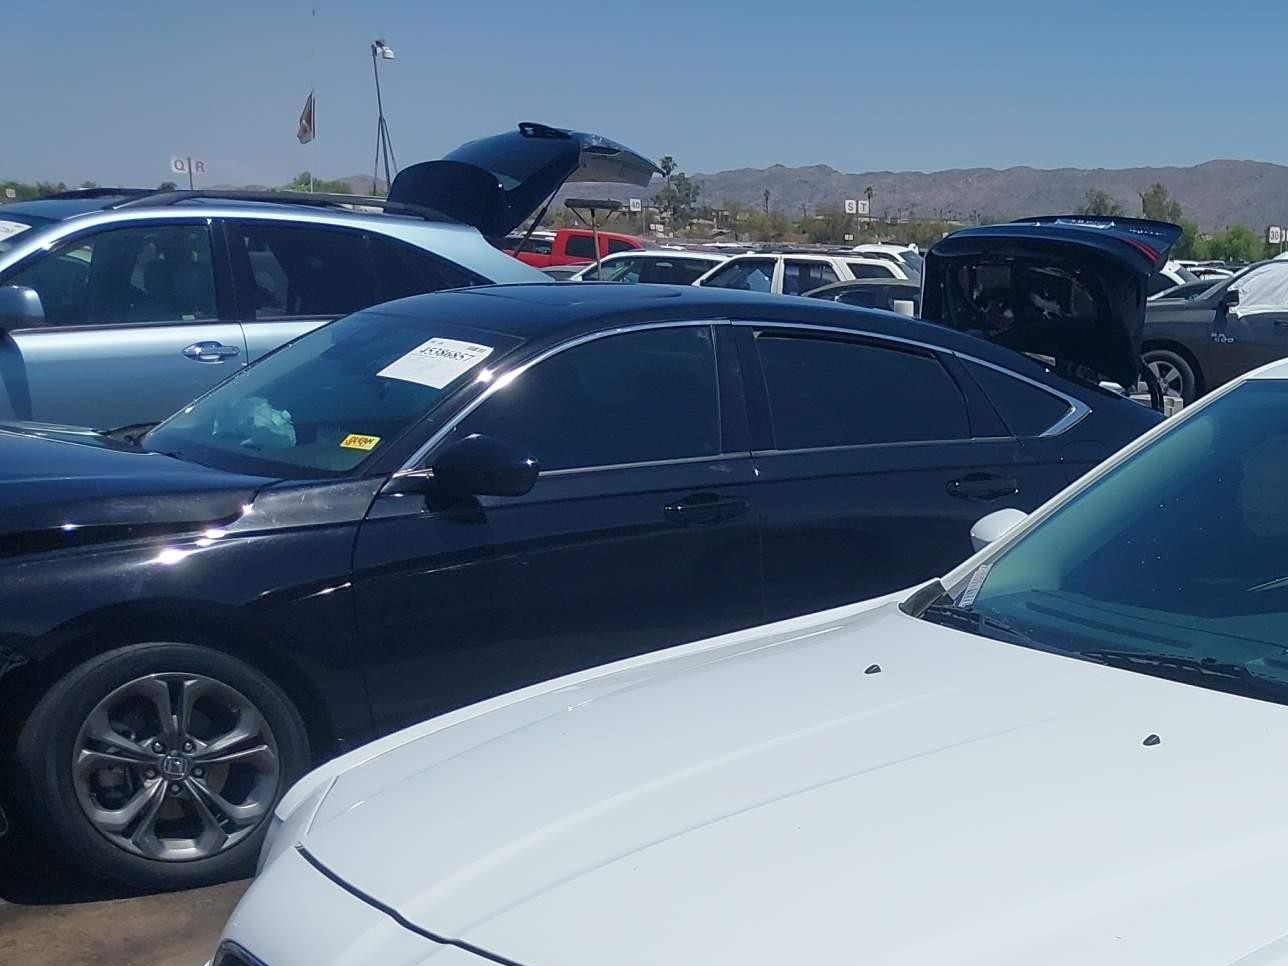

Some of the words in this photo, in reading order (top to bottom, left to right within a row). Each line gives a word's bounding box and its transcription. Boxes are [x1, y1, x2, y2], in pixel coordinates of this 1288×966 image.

[174, 159, 186, 171] Q
[195, 160, 205, 172] R
[847, 202, 855, 212] S
[860, 202, 868, 212] T
[1270, 230, 1280, 240] 30
